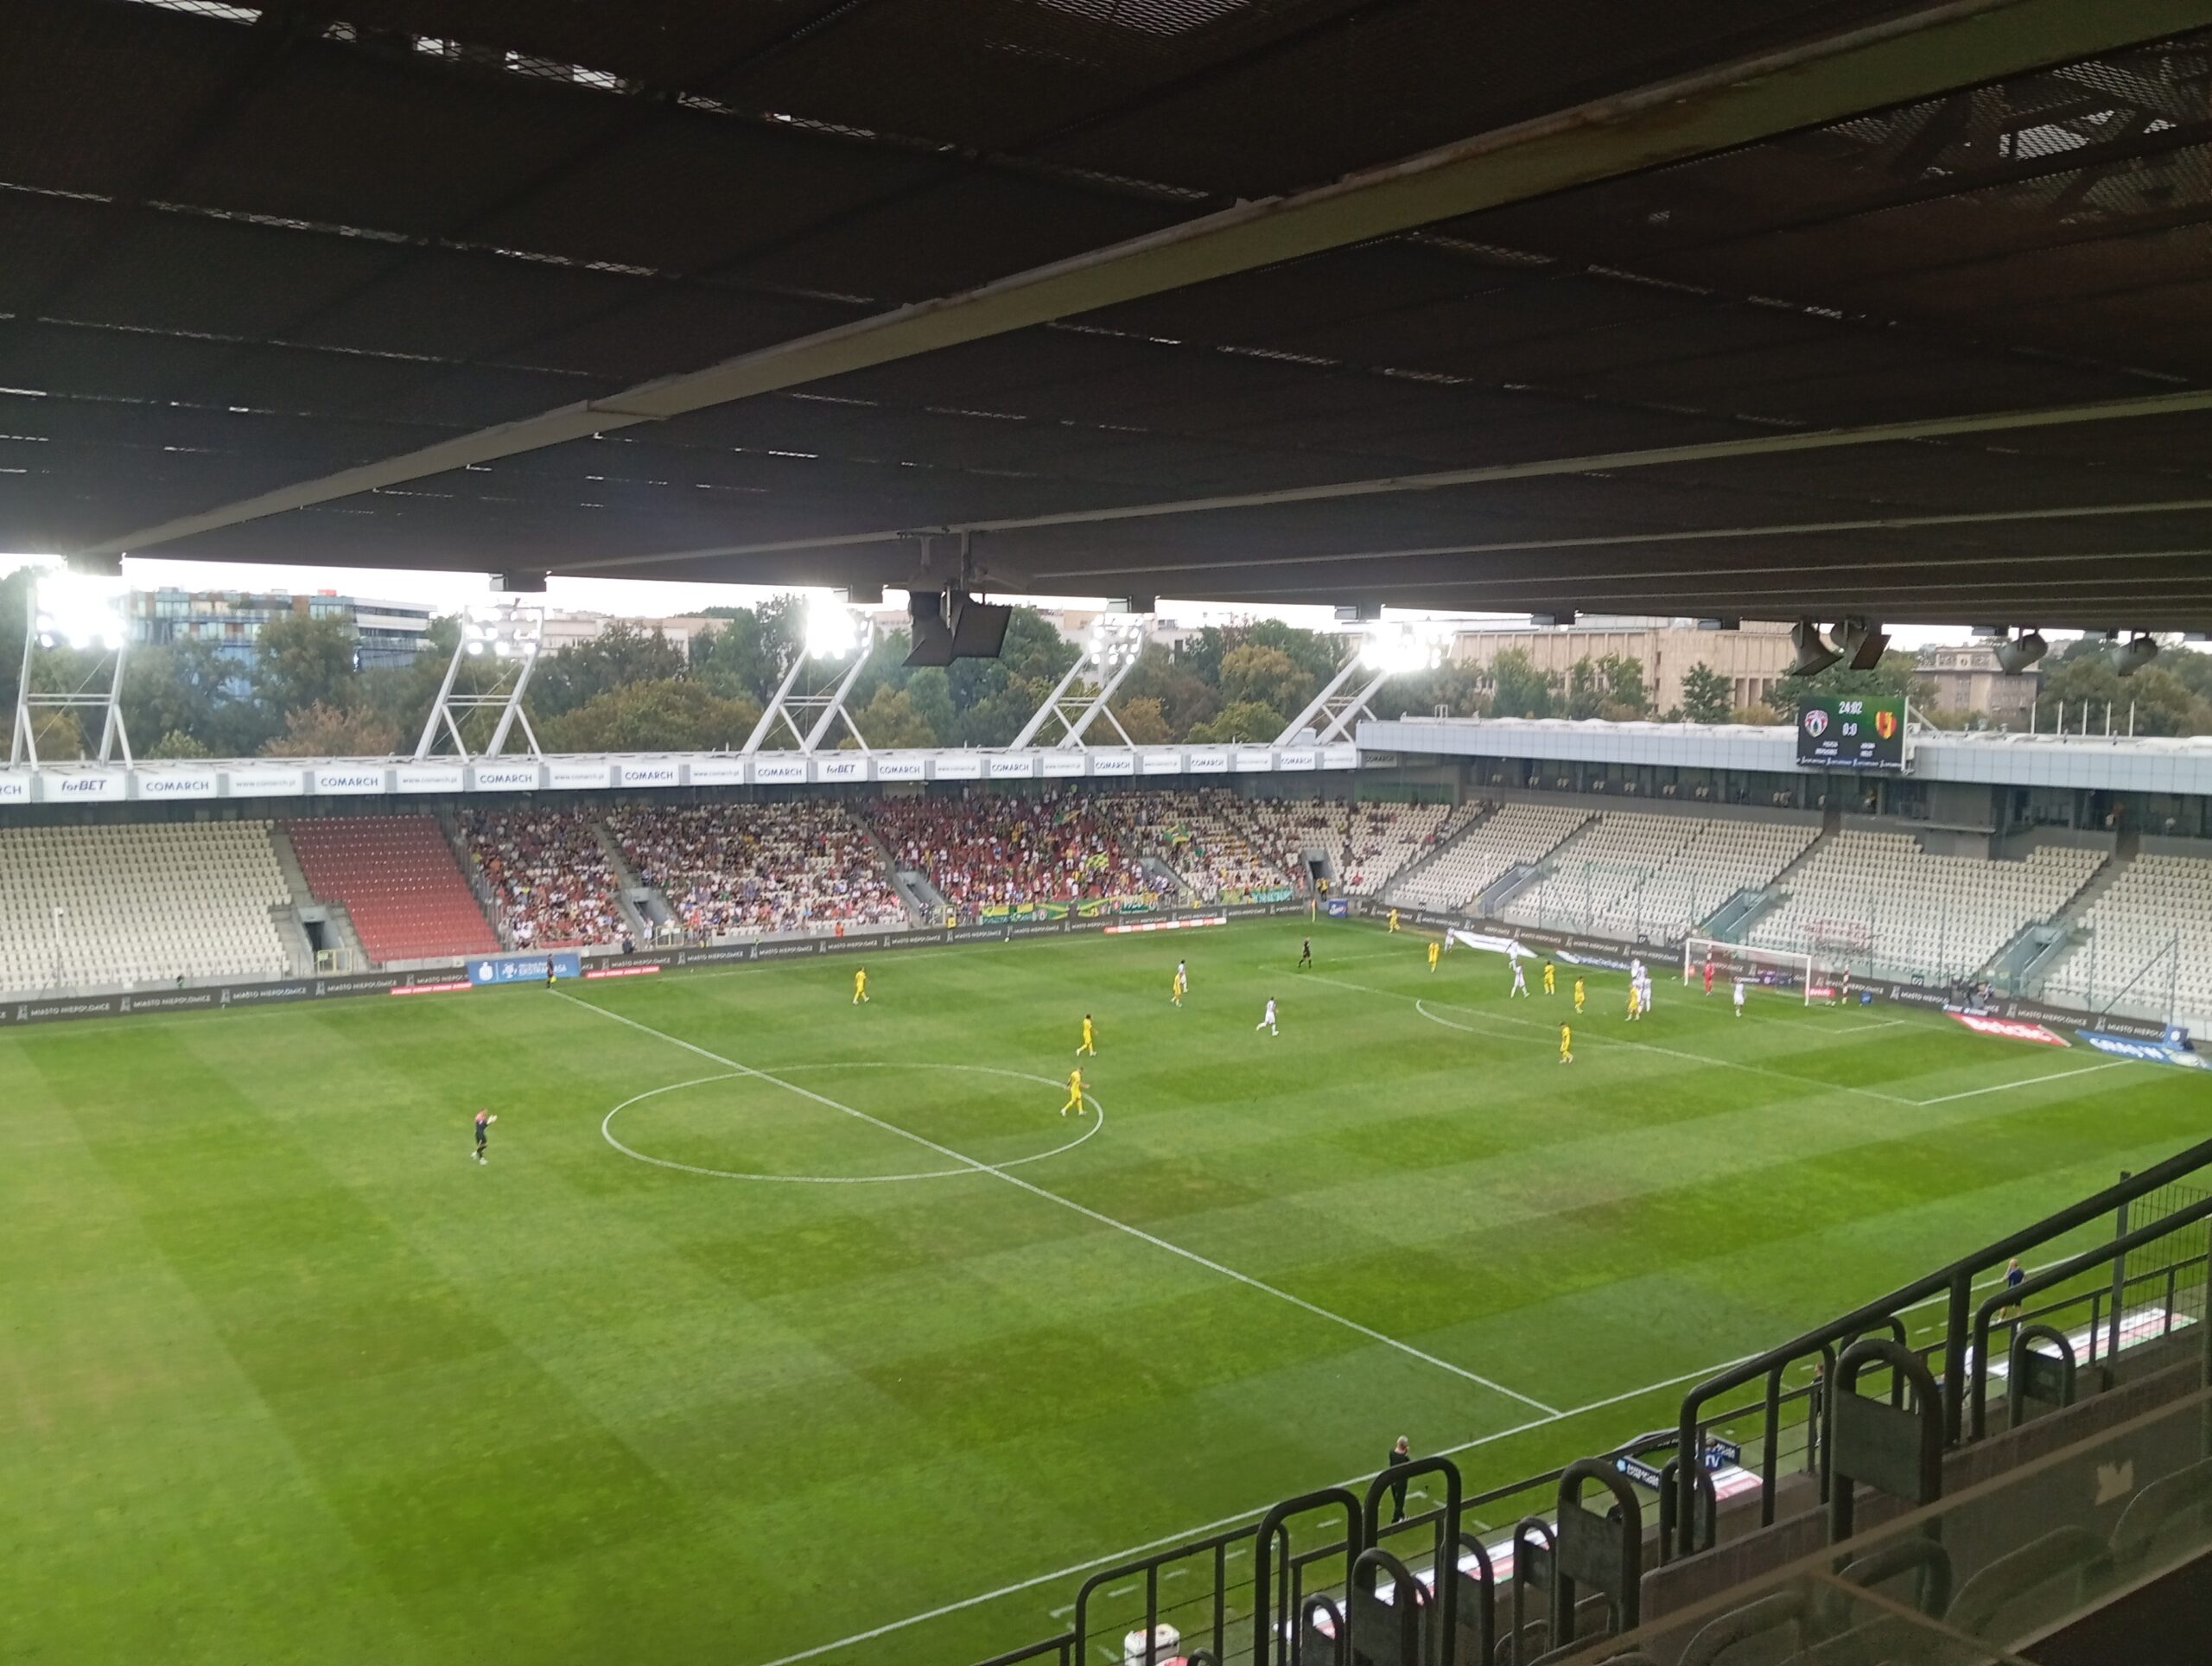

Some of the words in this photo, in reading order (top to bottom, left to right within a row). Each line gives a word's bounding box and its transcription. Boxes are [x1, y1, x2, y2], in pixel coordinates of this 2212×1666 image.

[758, 768, 802, 777] COMARCH
[826, 764, 855, 774] forBET
[480, 774, 532, 783] COMARCH
[625, 771, 673, 780] COMARCH
[61, 779, 107, 792] forBET
[145, 780, 209, 792] COMARCH
[321, 777, 378, 787] COMARCH
[327, 983, 352, 993] MIASTO
[232, 991, 259, 1000] MIASTO
[1901, 991, 1922, 1001] MIASTO
[133, 999, 161, 1008] MIASTO
[31, 1008, 59, 1017] MIASTO
[2018, 1009, 2041, 1020] MIASTO
[2107, 1023, 2133, 1034] MIASTO
